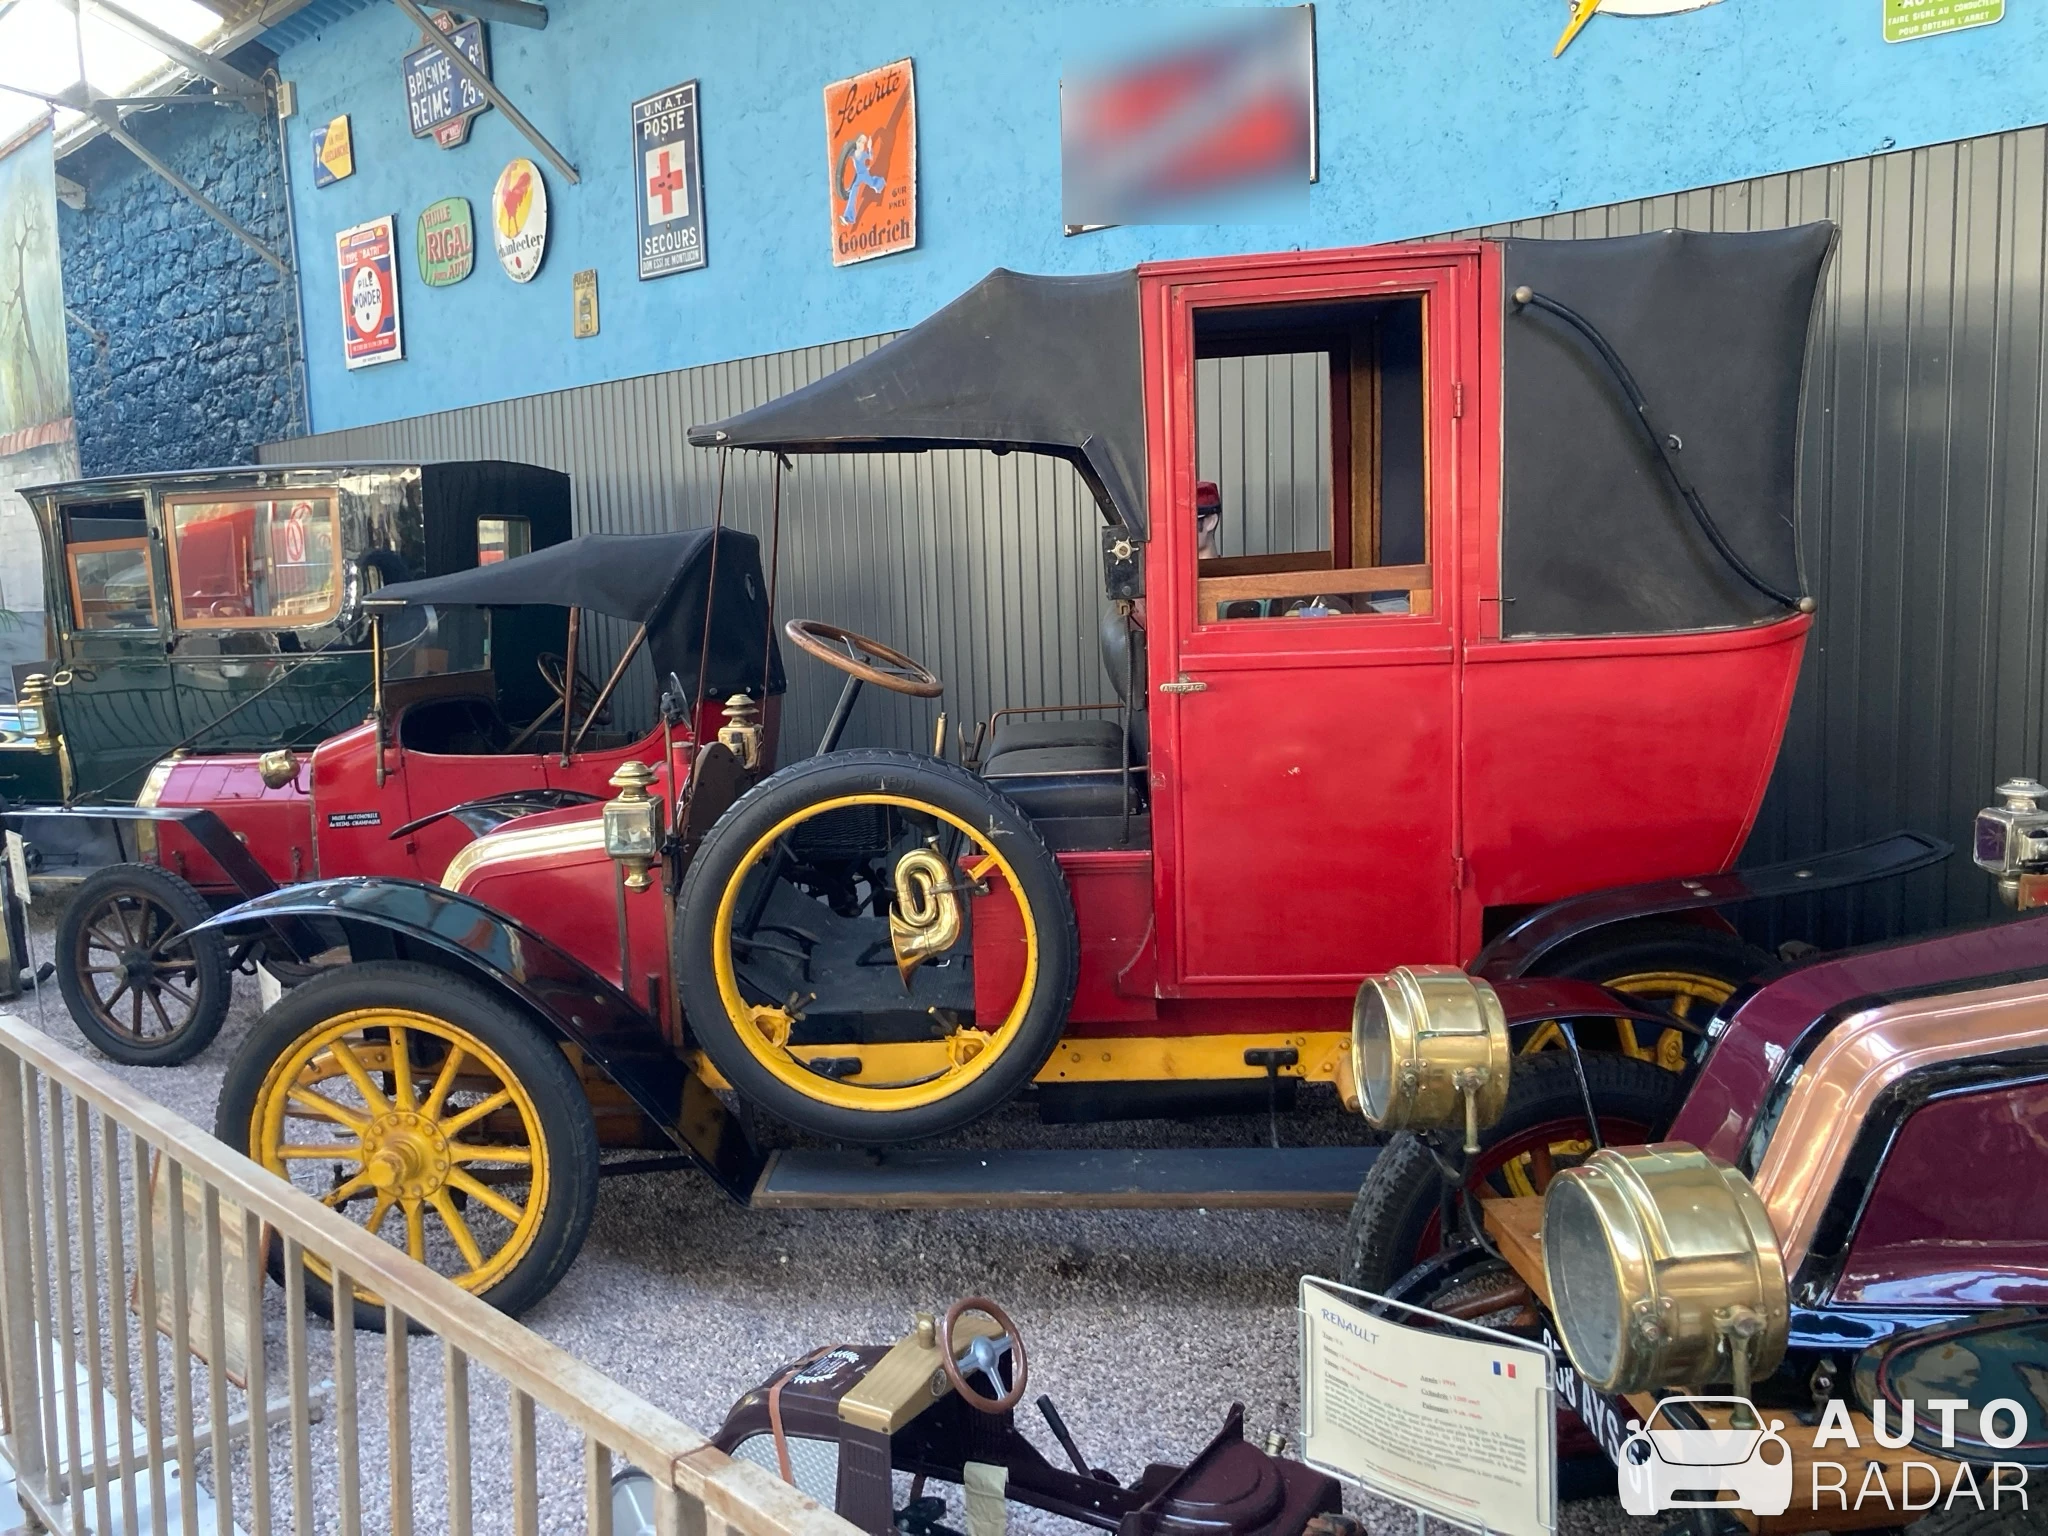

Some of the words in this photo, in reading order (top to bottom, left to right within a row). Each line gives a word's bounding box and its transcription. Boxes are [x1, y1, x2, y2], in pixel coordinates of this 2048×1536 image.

[1888, 15, 1909, 25] FAIRE
[1913, 9, 1935, 21] SIGNE
[1938, 7, 1949, 15] AU
[1899, 26, 1919, 35] POUR
[1922, 19, 1955, 31] OBTENIR
[411, 87, 452, 129] REIMS
[644, 94, 686, 116] U.N.A.T.
[644, 110, 685, 140] POSTE
[425, 205, 451, 229] HUILE
[427, 222, 472, 264] RIGAL
[645, 227, 697, 256] SECOURS
[838, 215, 911, 254] Goodrich
[358, 277, 373, 289] PILE
[354, 289, 381, 308] WONDER
[1321, 1307, 1379, 1345] RENAULT
[1582, 1380, 1620, 1467] AYS
